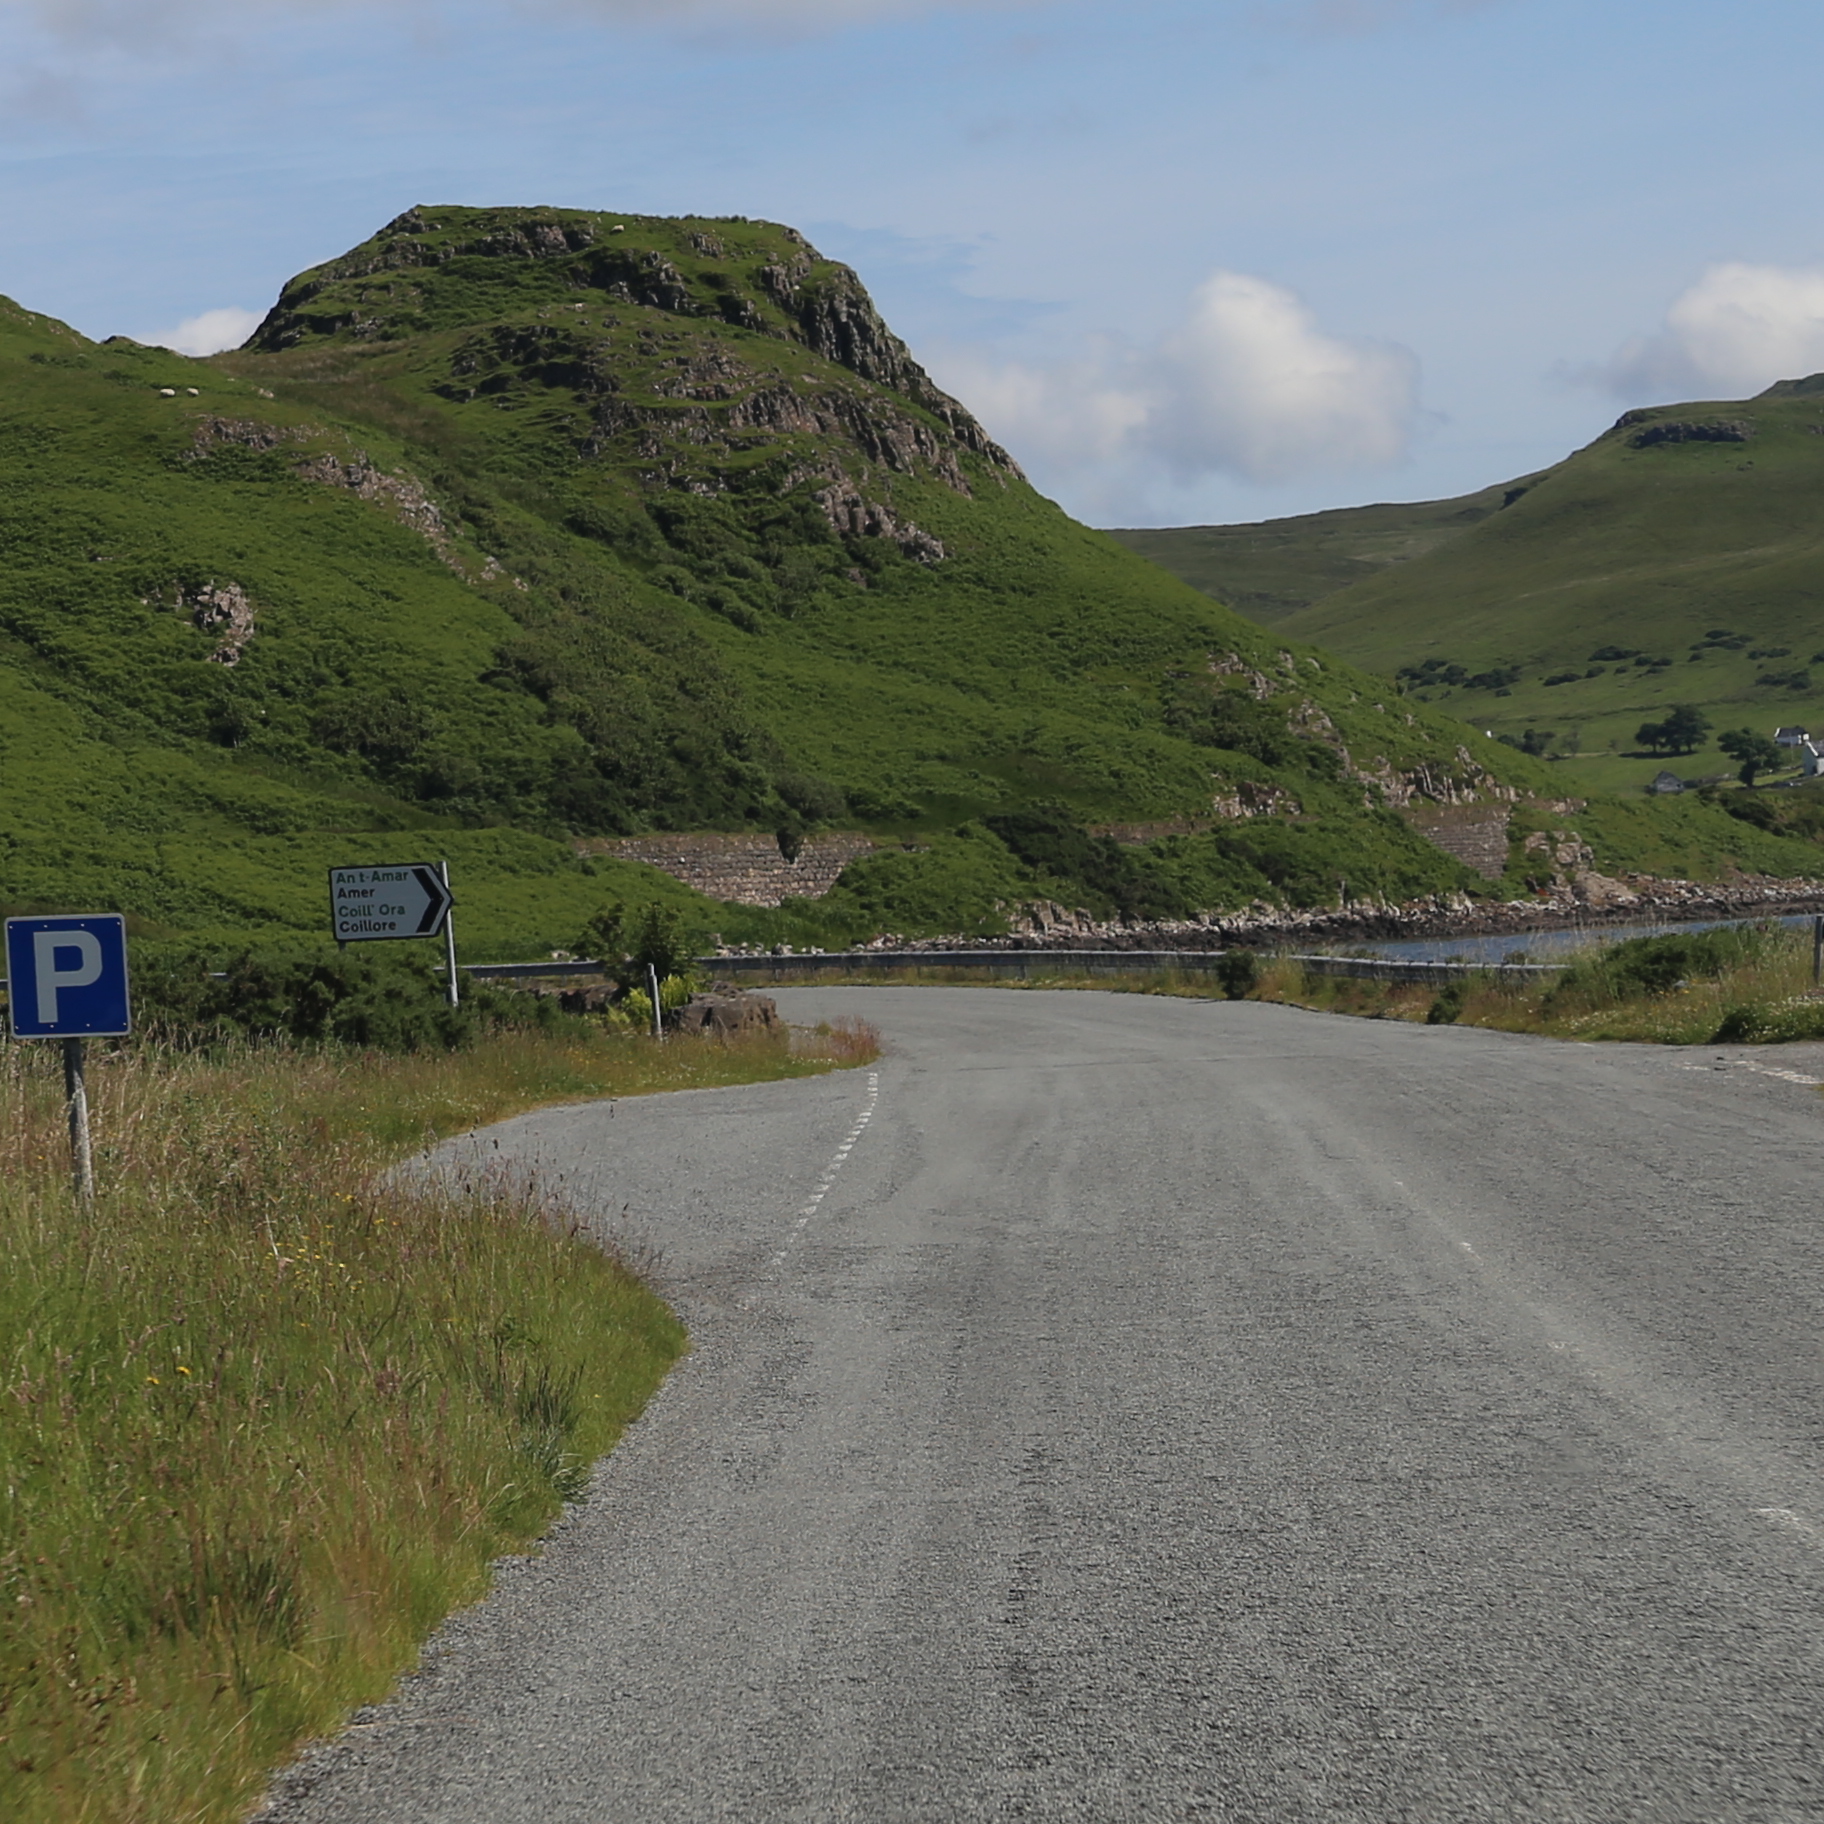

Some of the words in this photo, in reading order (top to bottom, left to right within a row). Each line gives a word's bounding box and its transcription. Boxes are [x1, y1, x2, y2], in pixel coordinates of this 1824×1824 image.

[336, 872, 355, 884] An
[337, 887, 376, 899] Amer
[379, 904, 406, 916] Ora
[339, 920, 397, 933] Coillore
[33, 930, 103, 1024] P
